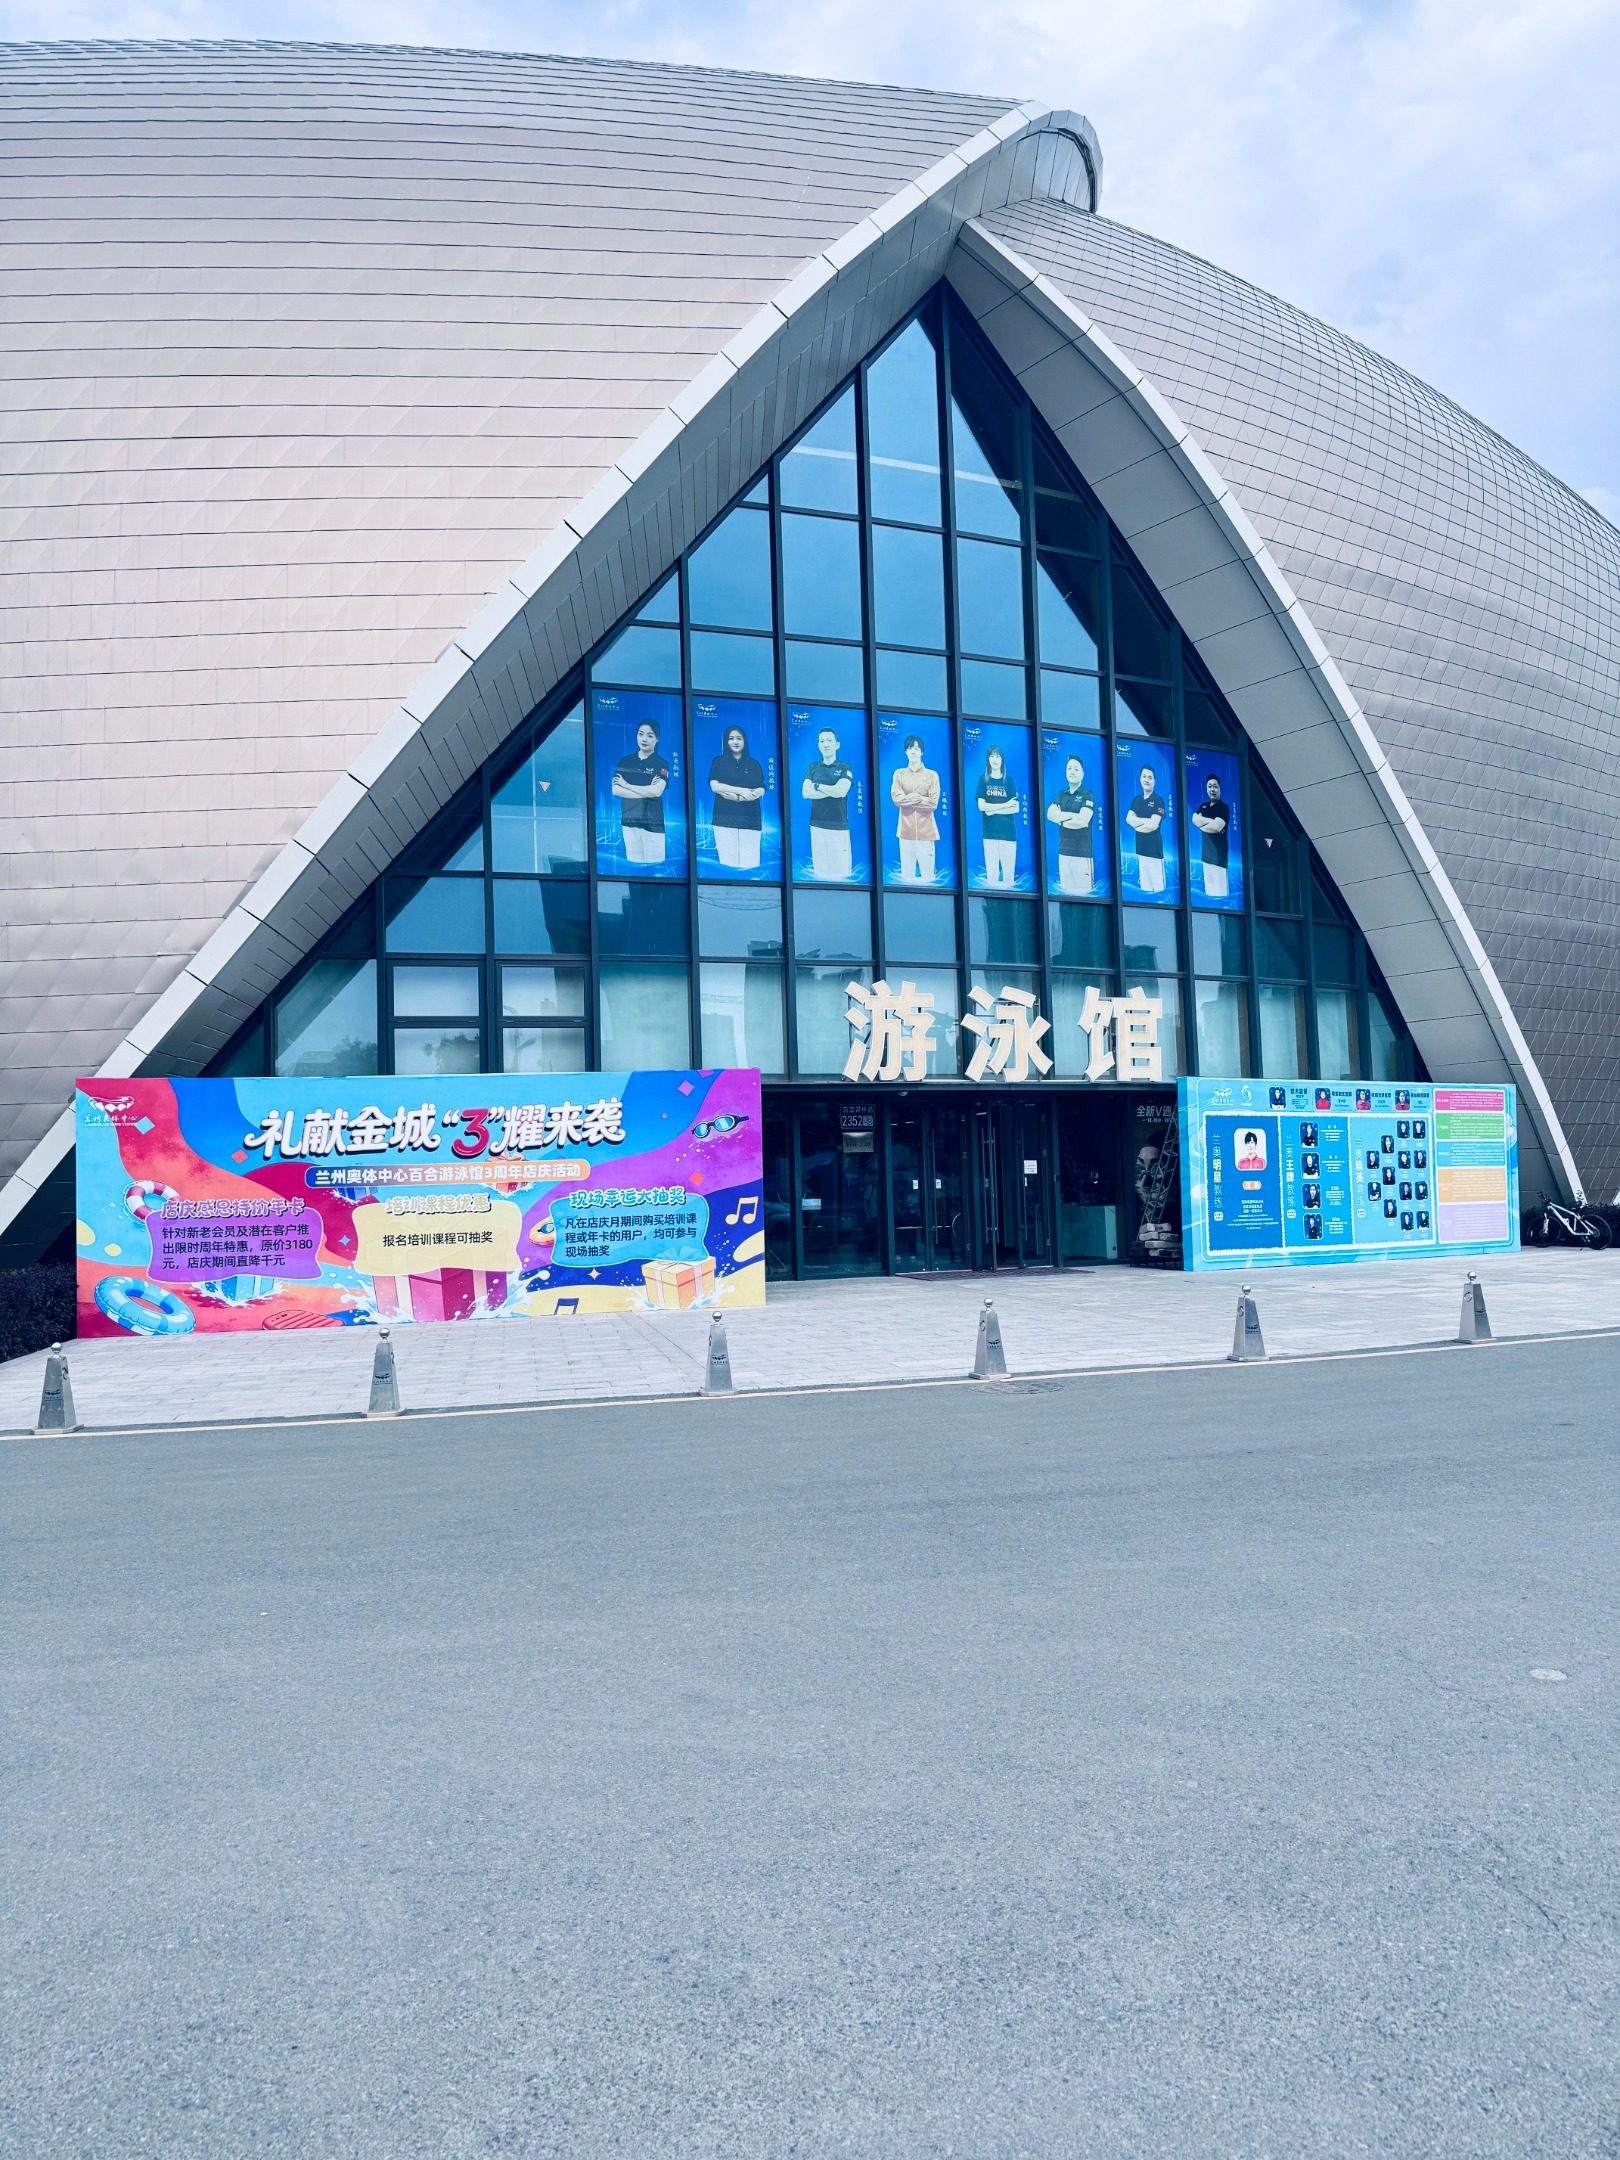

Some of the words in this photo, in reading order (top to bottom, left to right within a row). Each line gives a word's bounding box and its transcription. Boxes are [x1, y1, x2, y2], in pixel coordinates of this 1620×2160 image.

[986, 789, 1007, 798] CHINA
[842, 980, 1164, 1082] 游泳馆
[842, 1115, 863, 1127] 2352
[314, 1162, 582, 1184] 兰州奥体中心百合游泳馆3周年店庆活动
[385, 1193, 492, 1214] 培训课程优惠
[569, 1186, 686, 1207] 现场幸运大抽奖
[161, 1198, 305, 1219] 店庆感恩特价年卡
[564, 1213, 697, 1229] 凡在店庆月期间购买培训课
[162, 1224, 310, 1239] 针对新老会员及潜在客户推
[382, 1231, 493, 1247] 报名培训课程可抽奖
[564, 1228, 697, 1243] 程或年卡的用户，均可参与
[162, 1238, 313, 1255] 出限时周年特惠，原价3180
[564, 1245, 610, 1258] 现场抽奖
[162, 1255, 286, 1270] 元，店庆期间直降千元
